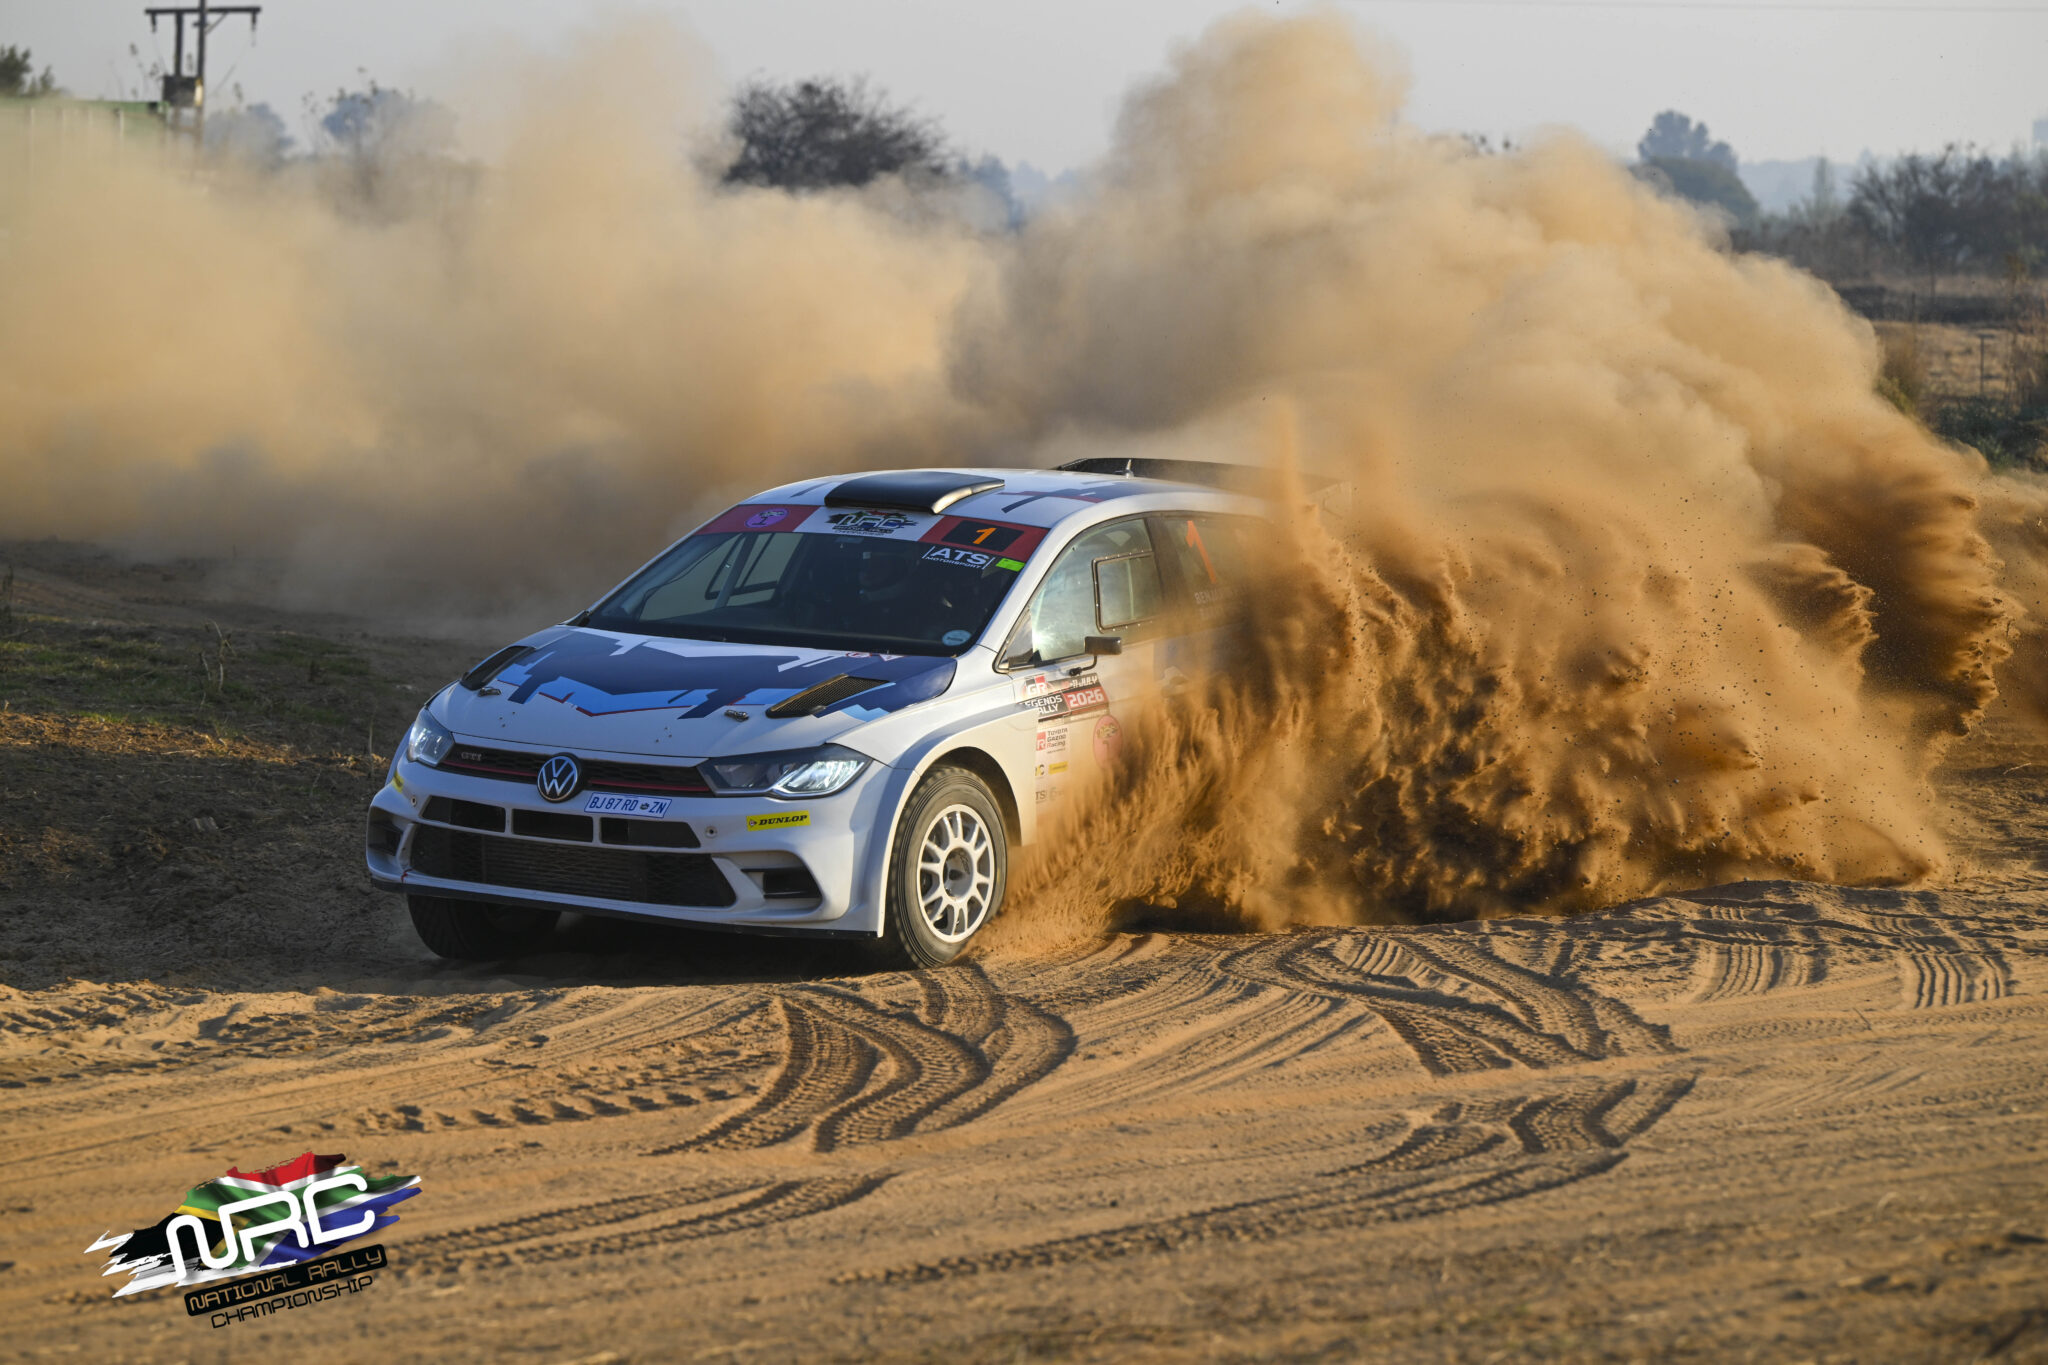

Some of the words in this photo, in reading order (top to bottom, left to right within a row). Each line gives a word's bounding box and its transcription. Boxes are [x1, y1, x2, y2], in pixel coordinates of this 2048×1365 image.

[972, 527, 997, 545] 1
[930, 547, 990, 565] ATS
[1186, 520, 1217, 584] 1
[1026, 682, 1047, 696] GR
[1020, 694, 1063, 708] EGENDS
[589, 796, 606, 809] BJ
[605, 798, 622, 810] 87
[621, 799, 639, 811] RD
[648, 801, 667, 814] ZN
[758, 813, 808, 827] DUNLOP
